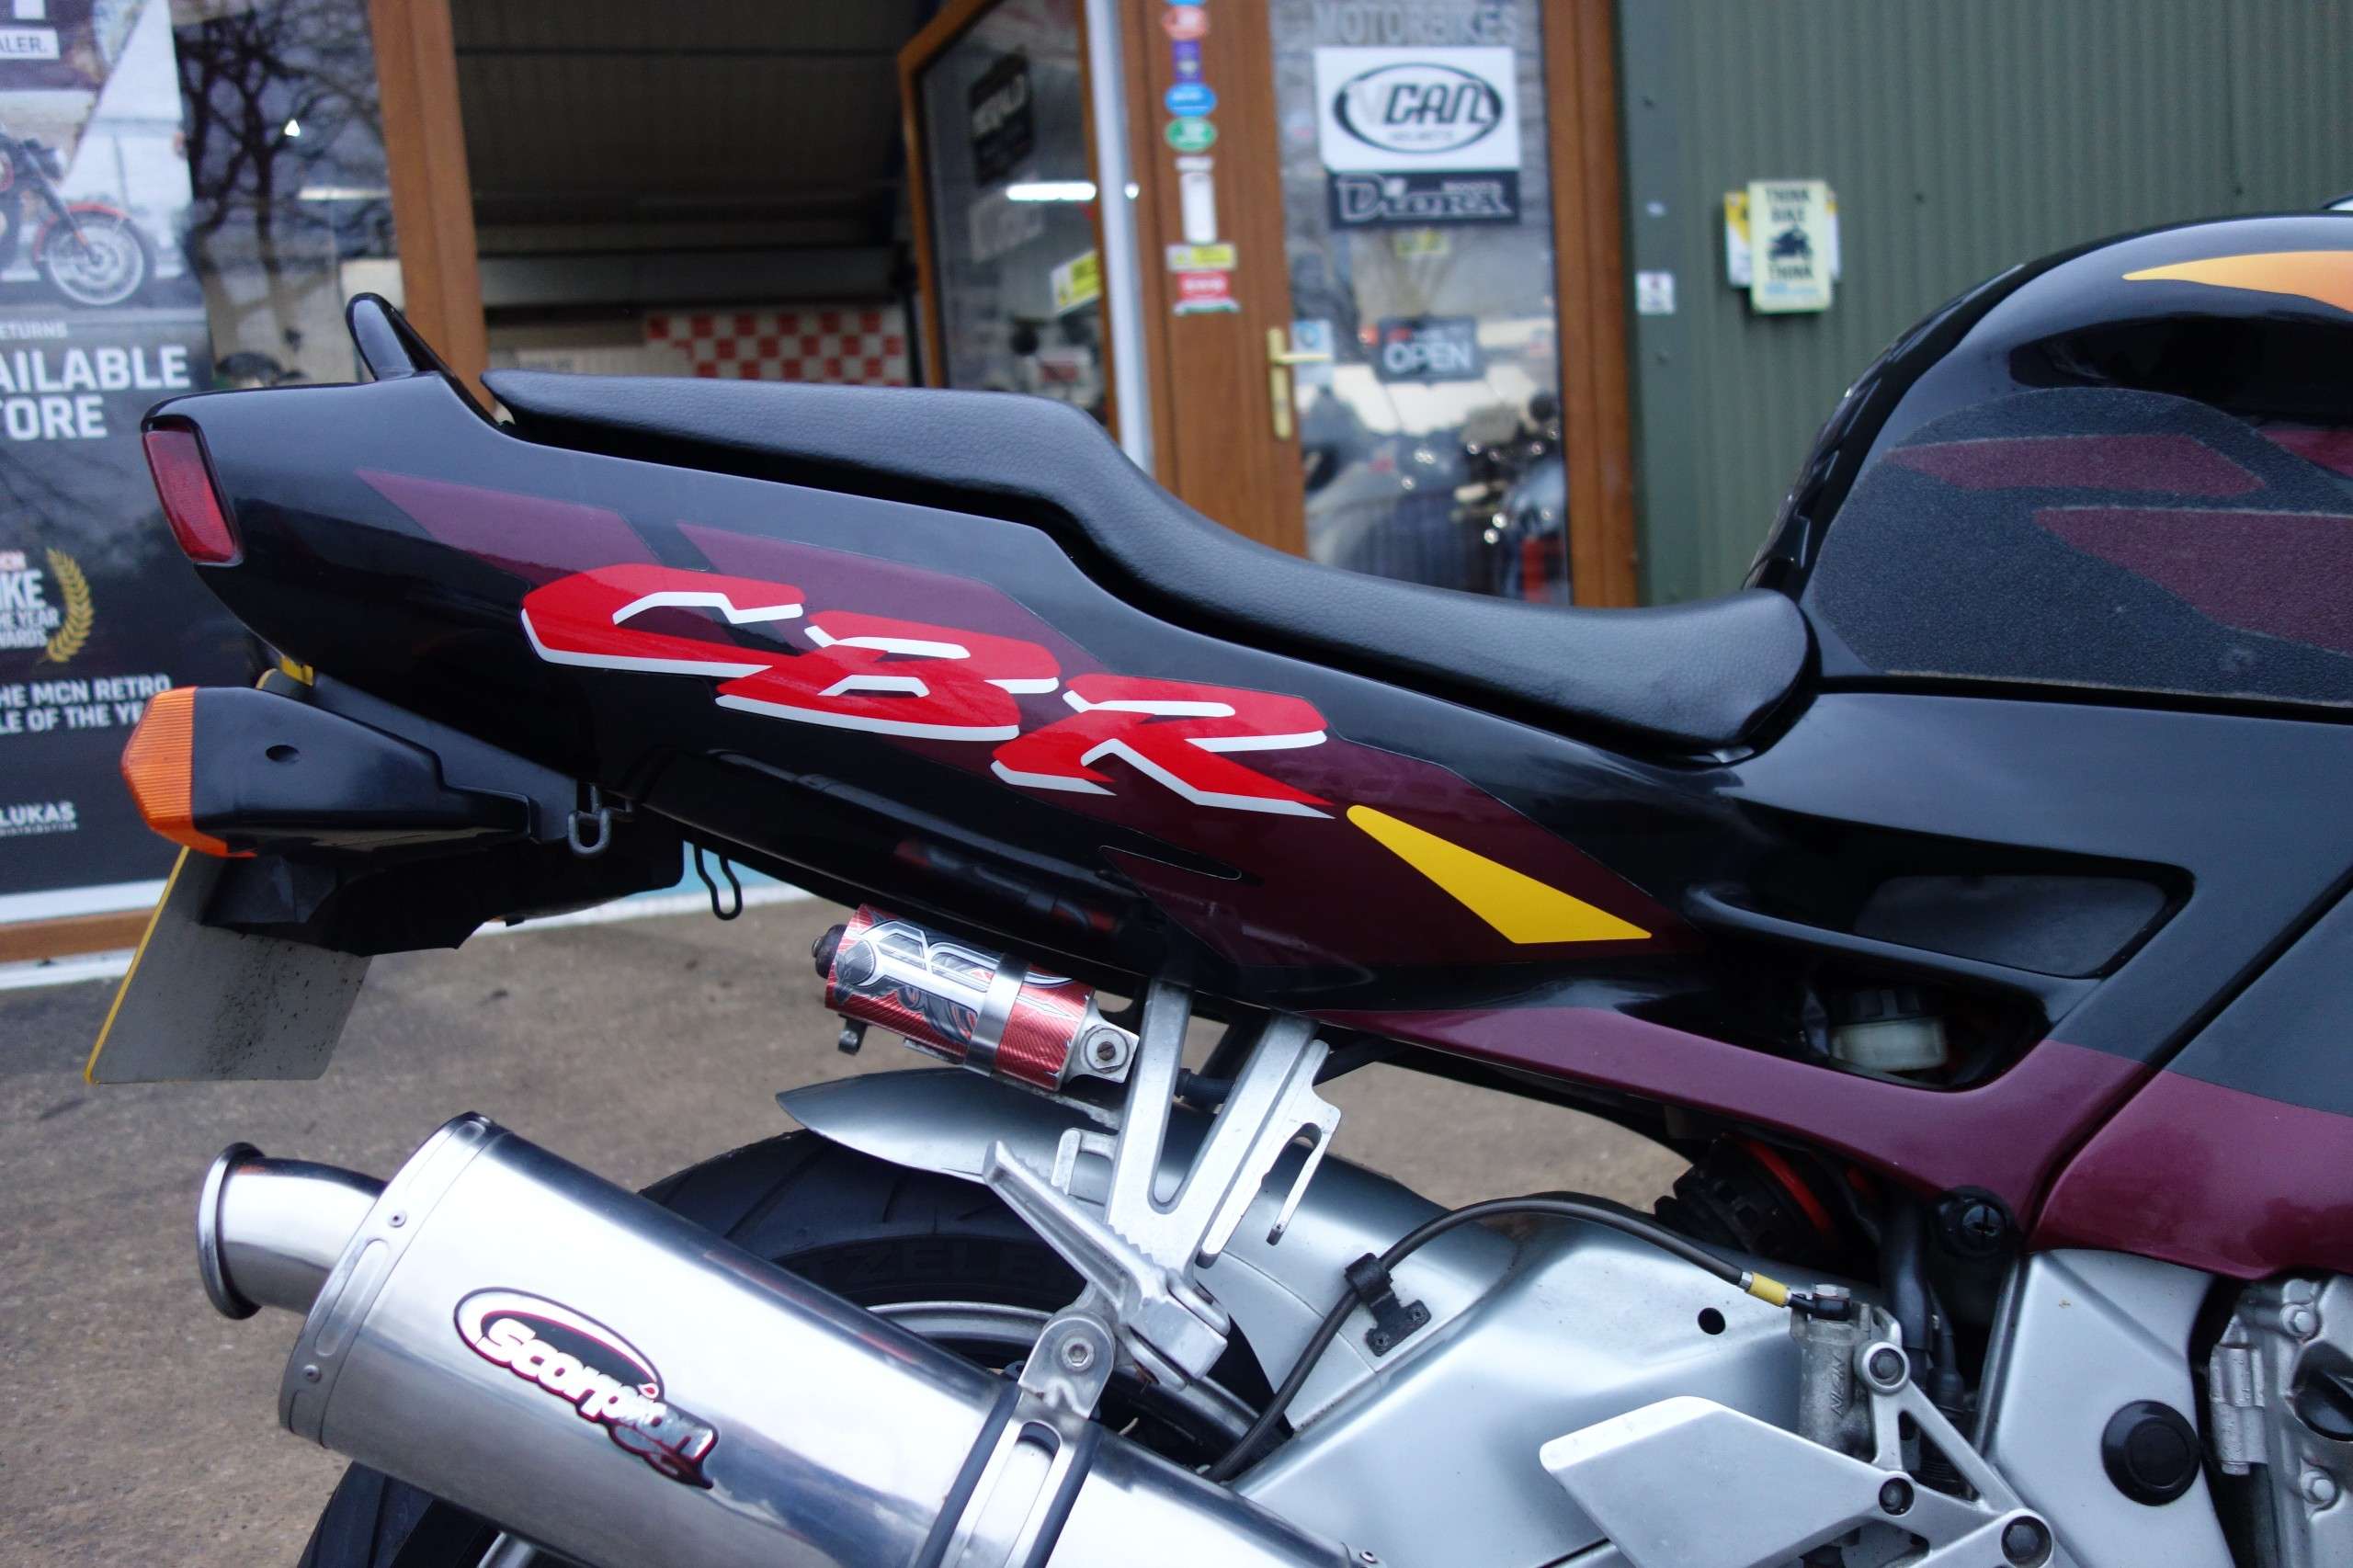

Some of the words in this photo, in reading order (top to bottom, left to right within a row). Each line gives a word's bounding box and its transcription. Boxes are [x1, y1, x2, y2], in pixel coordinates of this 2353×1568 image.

[1383, 341, 1472, 373] OPEN
[0, 394, 108, 441] ORE
[30, 679, 90, 707] MCN
[92, 673, 172, 702] RETRO
[520, 562, 1336, 819] CBR
[27, 707, 60, 733] OF
[63, 702, 111, 730] THE
